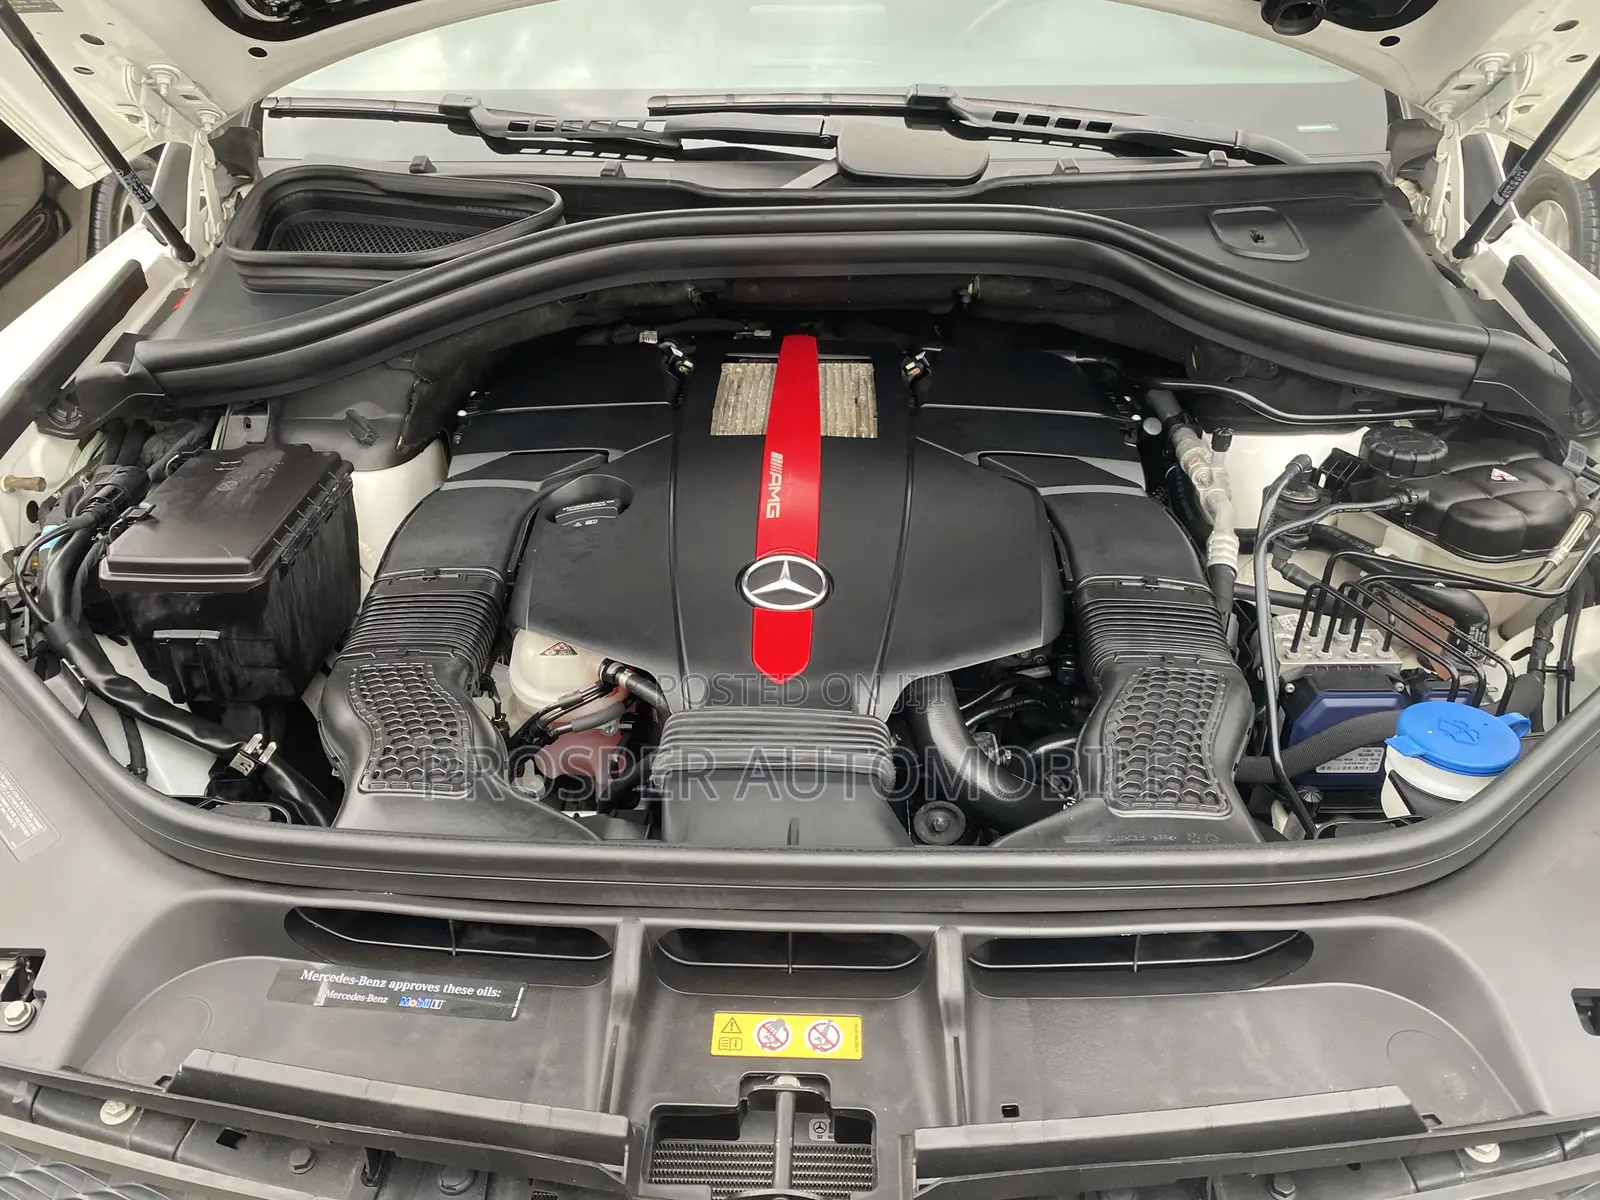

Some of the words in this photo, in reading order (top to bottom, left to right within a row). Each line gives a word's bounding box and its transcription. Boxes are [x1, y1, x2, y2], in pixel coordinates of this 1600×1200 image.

[300, 969, 387, 988] Mercedes-Benz
[388, 979, 440, 993] approves
[443, 983, 474, 995] these
[476, 986, 502, 998] oils:
[324, 989, 389, 1004] Mercedes-Benz
[398, 996, 431, 1009] Mobil
